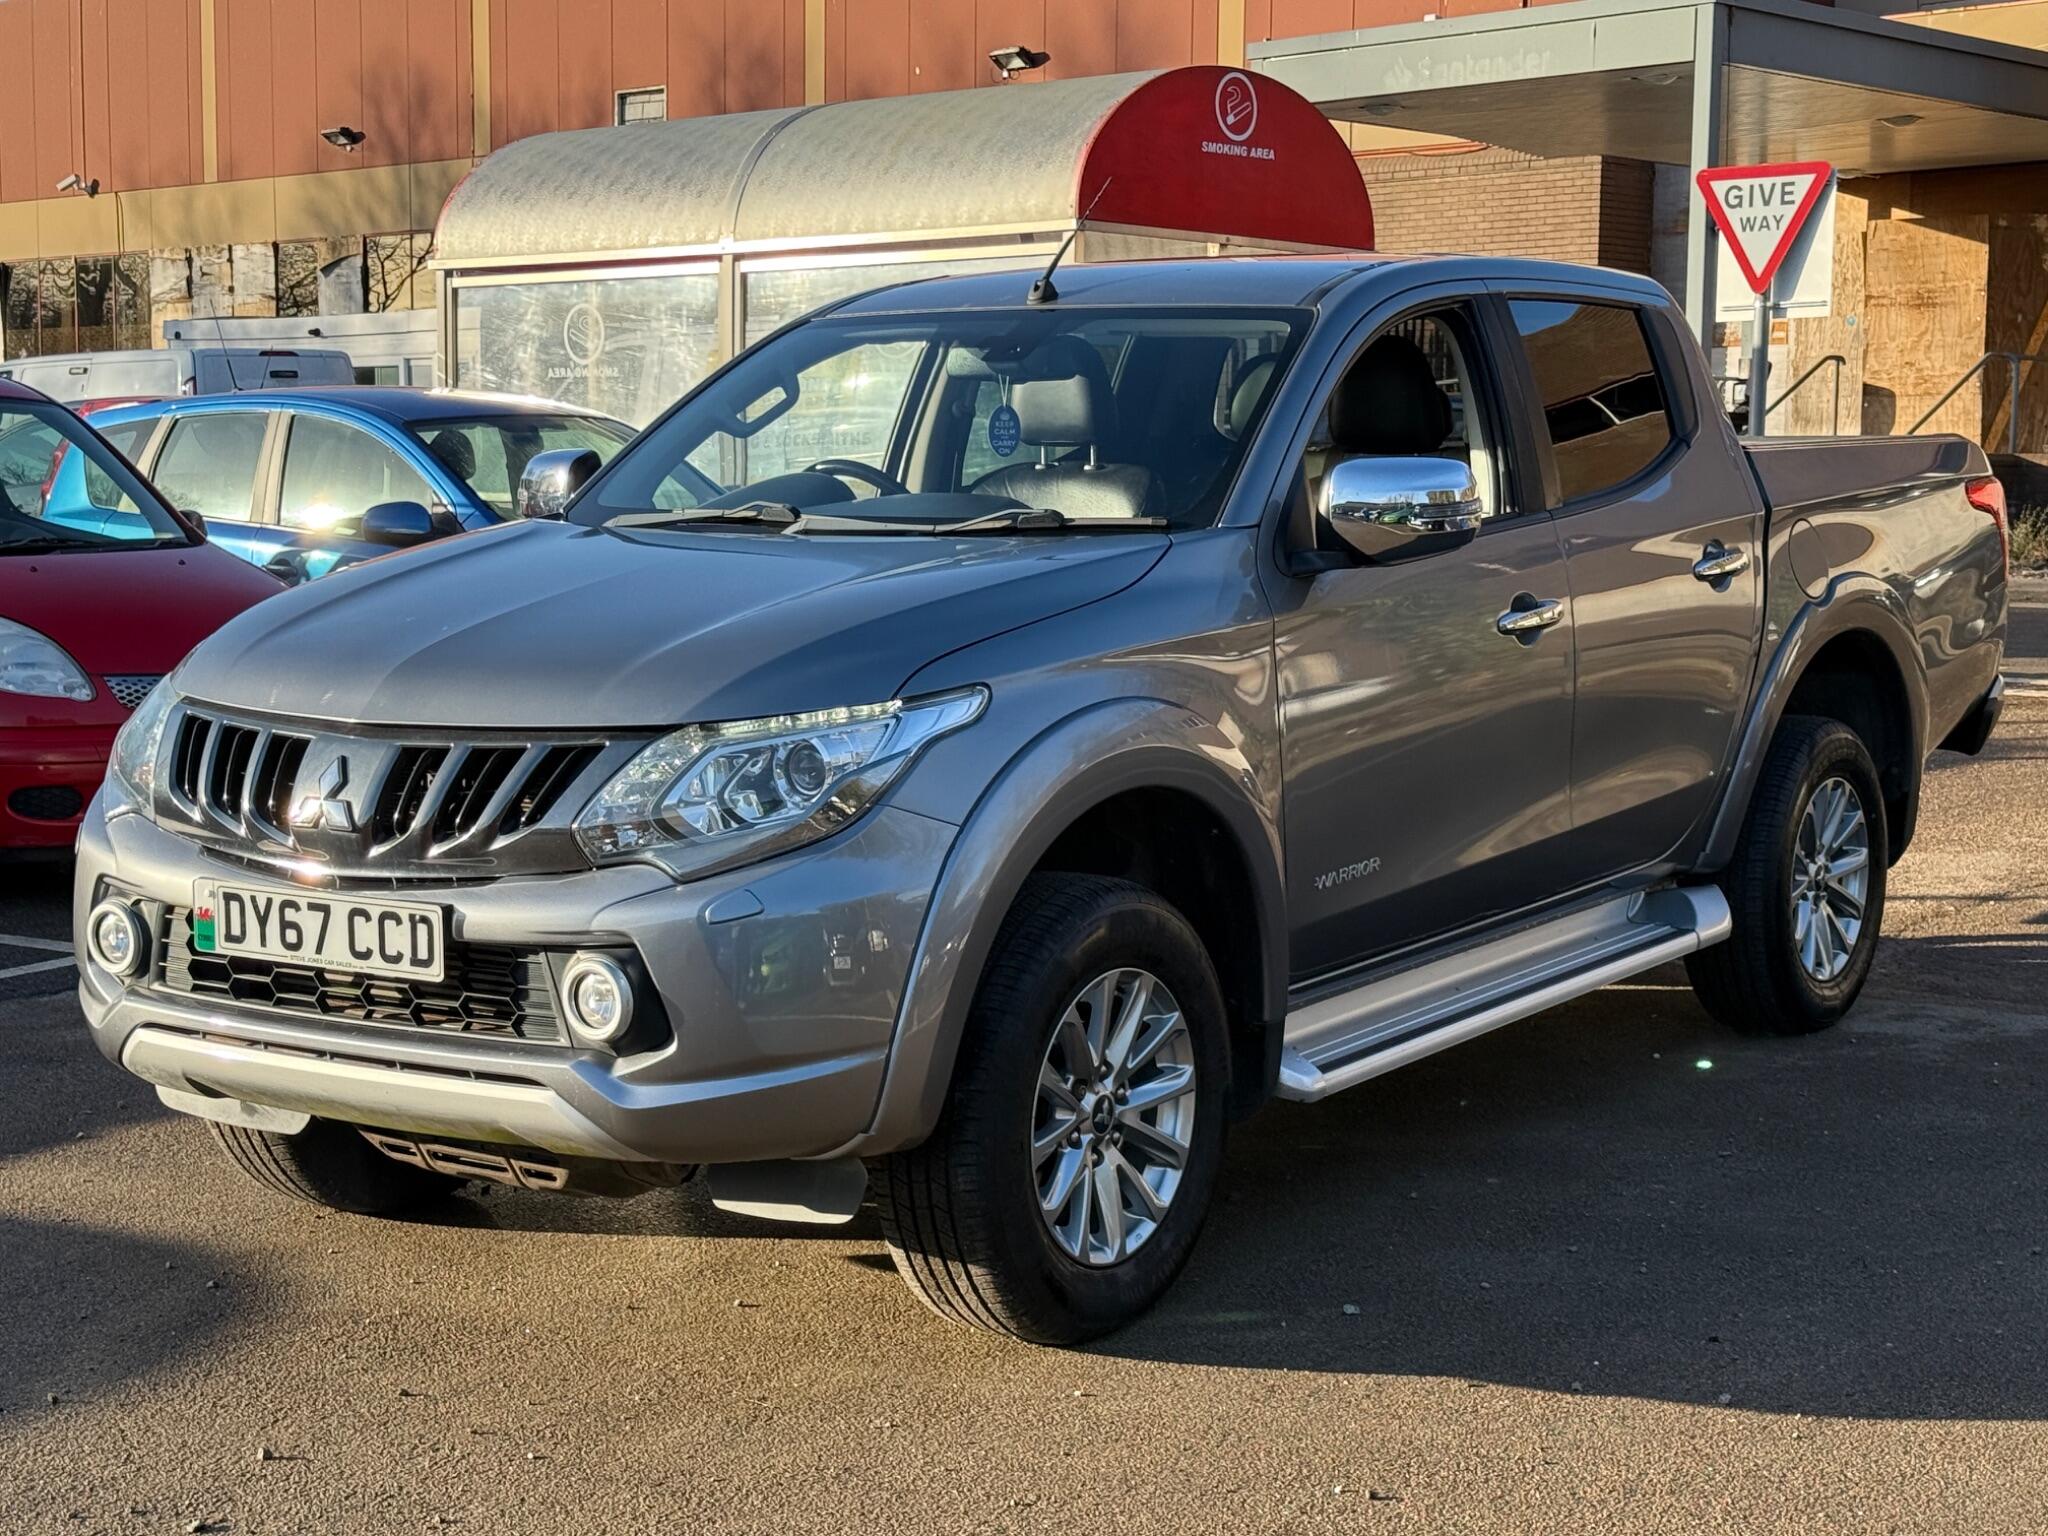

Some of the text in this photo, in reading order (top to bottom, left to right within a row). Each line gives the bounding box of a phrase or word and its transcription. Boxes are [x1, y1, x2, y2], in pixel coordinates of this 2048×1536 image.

[1418, 48, 1551, 81] Santander
[1201, 141, 1275, 160] SMOKING AREA
[1724, 181, 1796, 209] GIVE
[1740, 214, 1785, 233] WAY
[1314, 857, 1381, 890] WARRIOR
[222, 891, 435, 969] DY67 CCD
